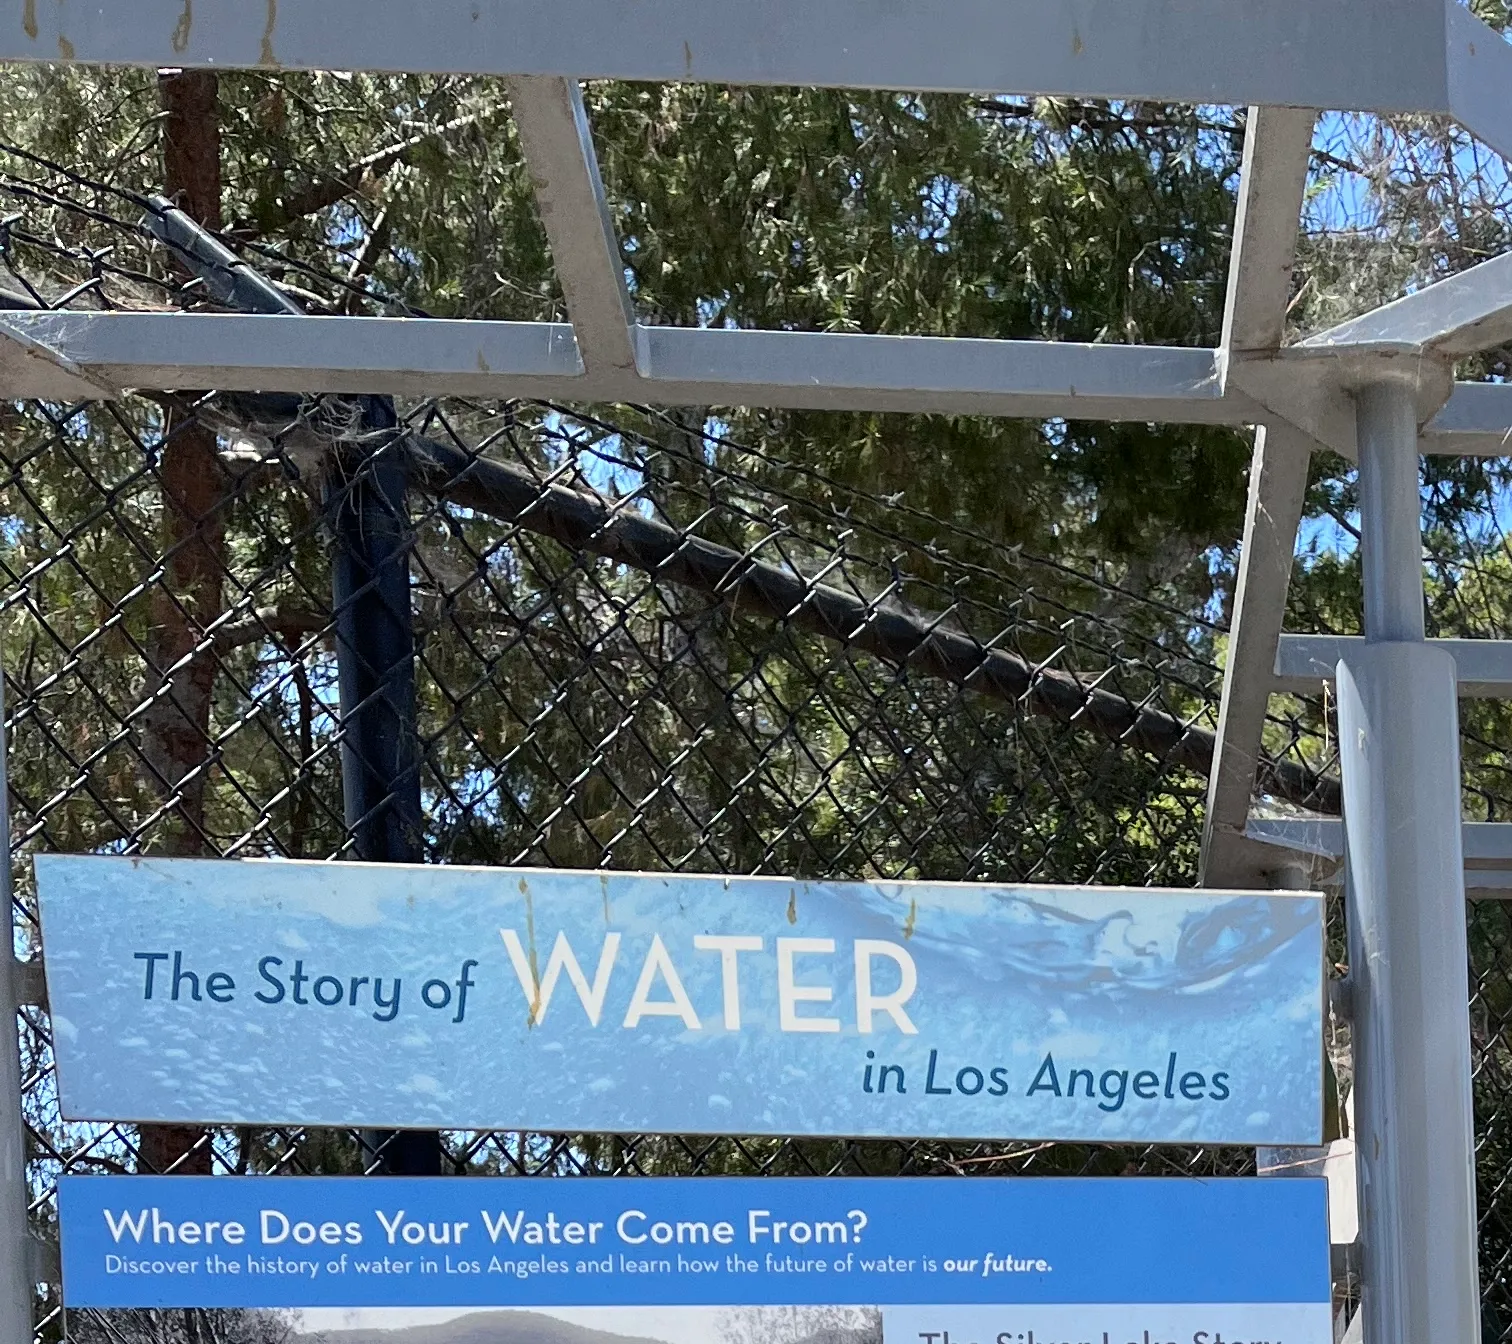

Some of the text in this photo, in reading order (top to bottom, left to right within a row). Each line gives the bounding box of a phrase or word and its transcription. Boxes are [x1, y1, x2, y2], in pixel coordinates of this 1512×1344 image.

[134, 928, 918, 1035] The Story of WATER
[863, 1049, 1229, 1109] in Los Angeles
[104, 1208, 867, 1244] Where Does Your Water Come From?
[105, 1252, 1052, 1278] Discover the history of water in Los Angeles and learn how the future of water is our future.
